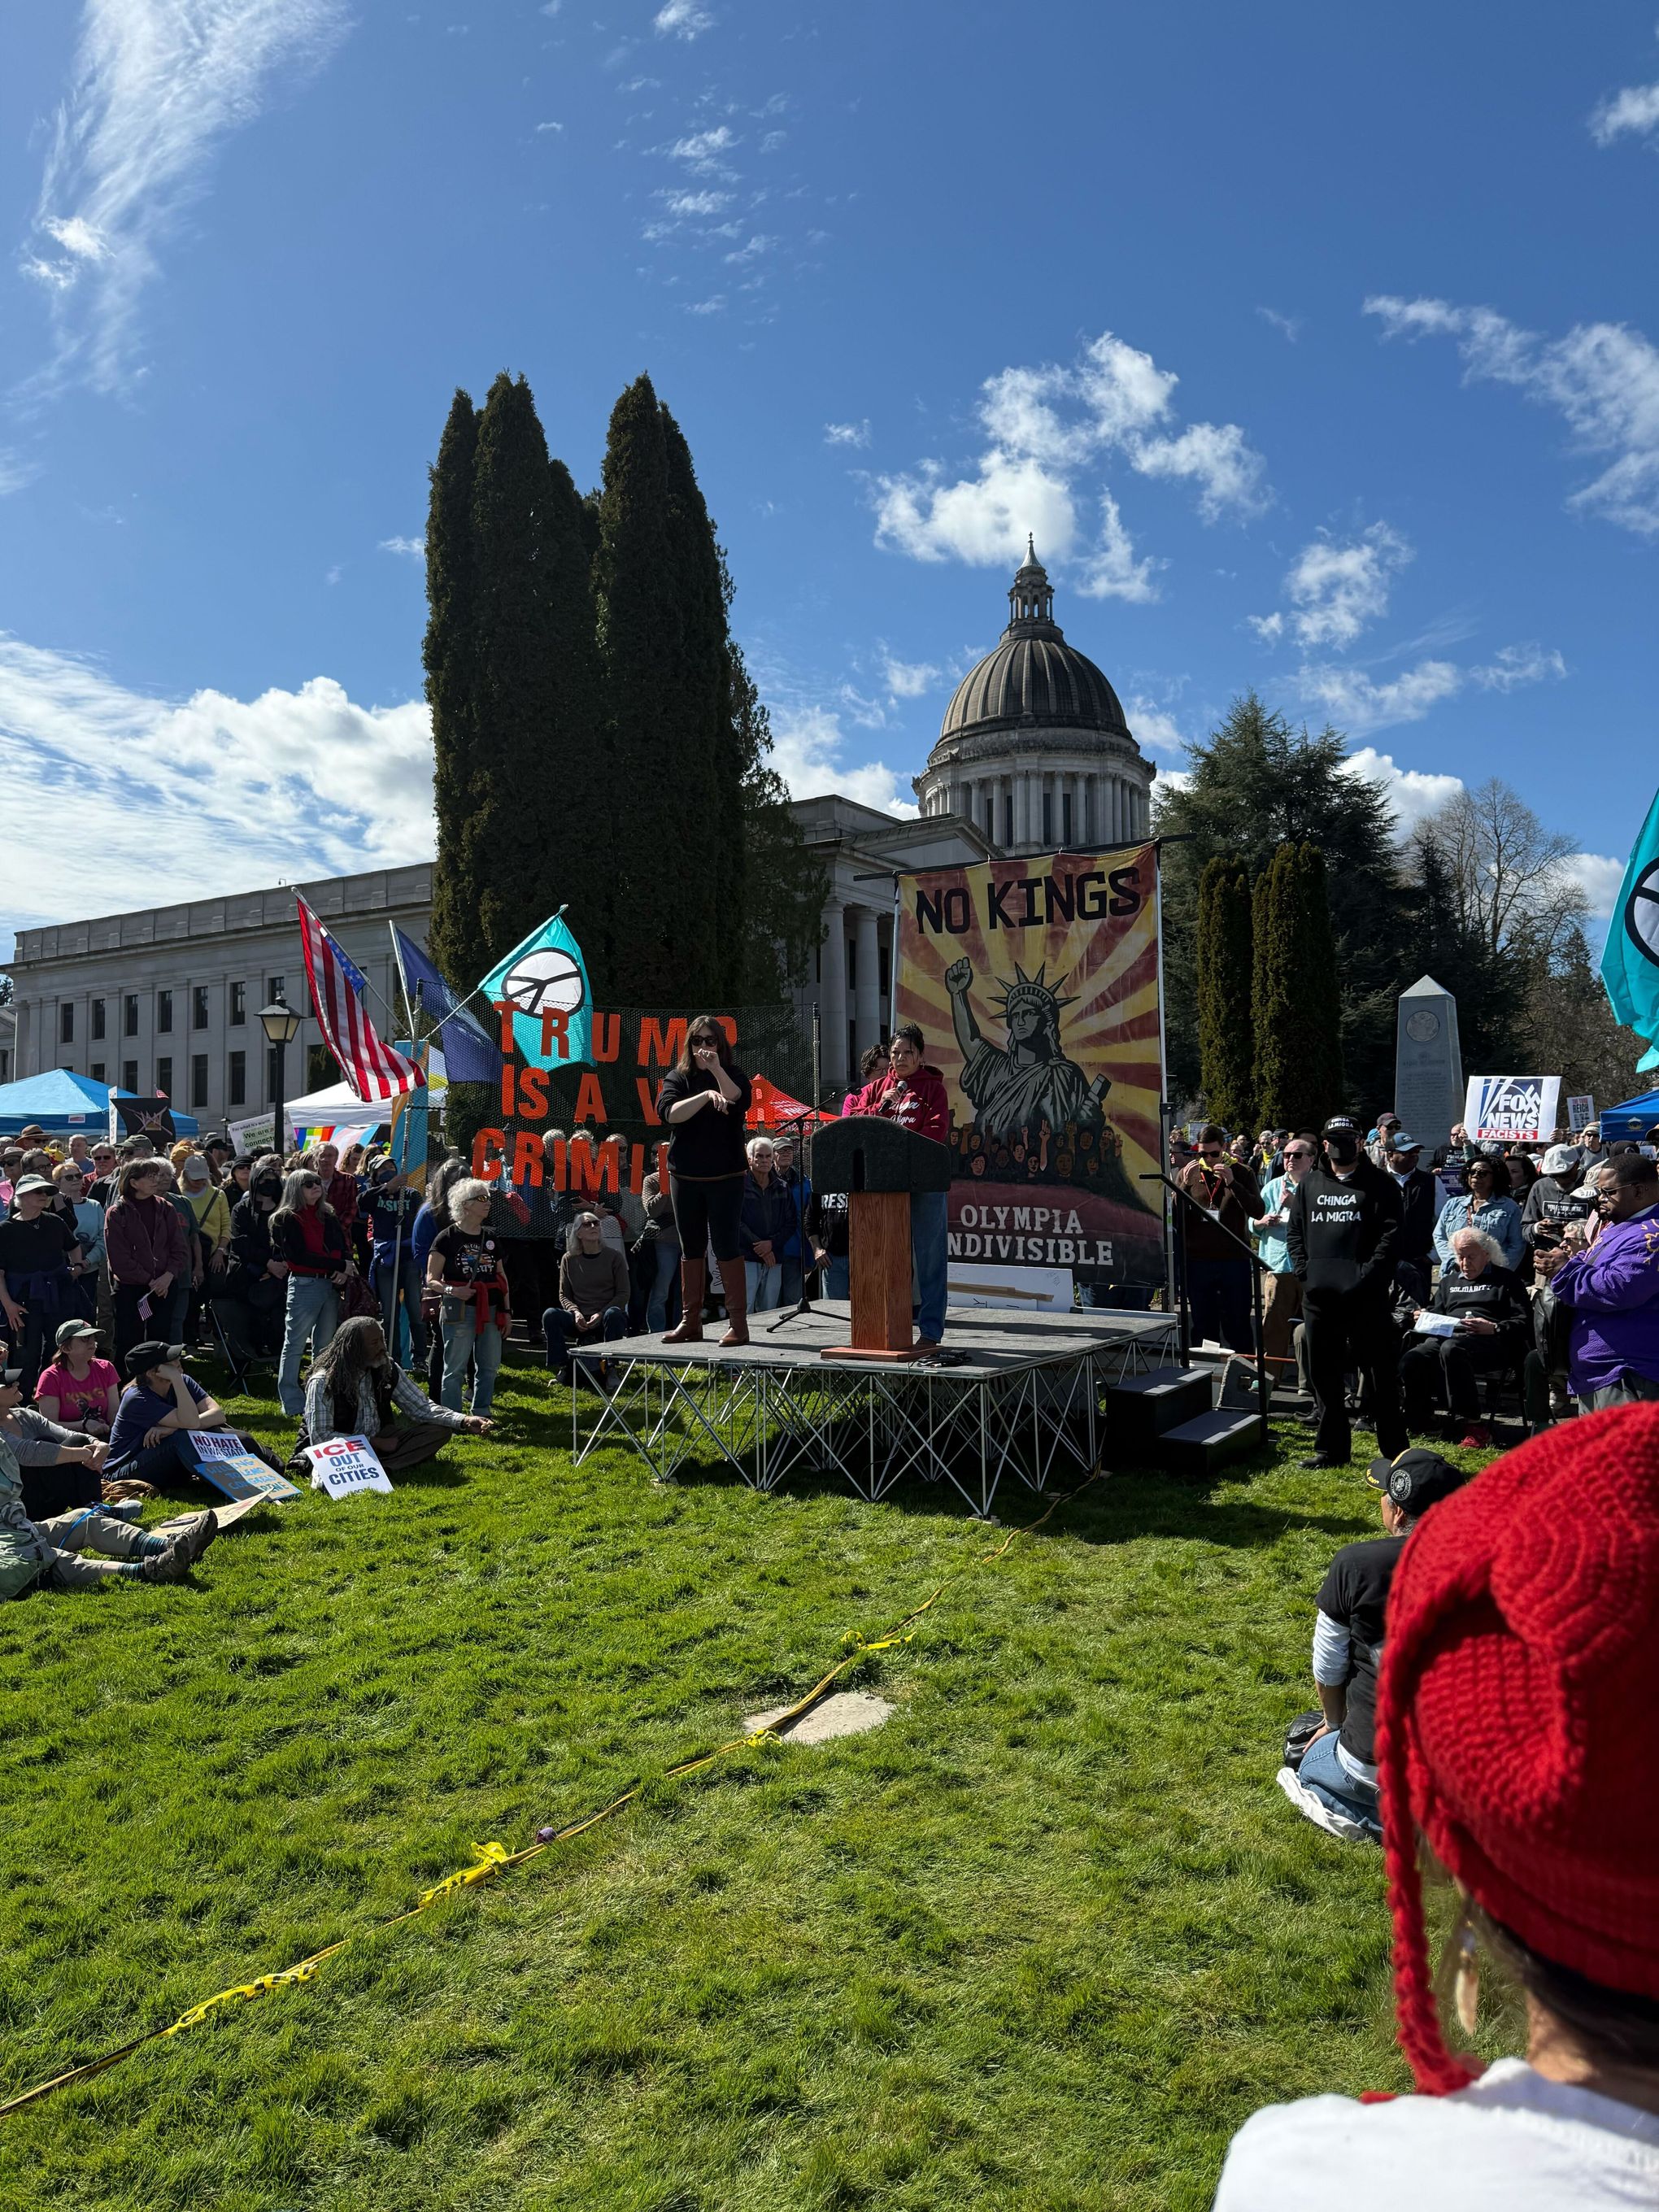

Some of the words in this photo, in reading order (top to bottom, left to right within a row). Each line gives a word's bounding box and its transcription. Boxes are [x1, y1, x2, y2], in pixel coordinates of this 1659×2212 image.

[917, 888, 970, 934] NO
[987, 867, 1140, 930] KINGS
[502, 1064, 550, 1120] IS
[574, 1073, 607, 1123] A
[1487, 1112, 1539, 1129] NEWS
[245, 1136, 275, 1147] connect
[1482, 1130, 1535, 1139] FACISTS
[1317, 1195, 1356, 1205] CHINGA
[960, 1204, 1084, 1234] OLYMPIA
[1311, 1211, 1323, 1222] LA
[1326, 1211, 1362, 1222] MIGRA
[947, 1233, 1113, 1266] NDIVISIBLE
[1450, 1284, 1491, 1293] SOLIDARITY
[193, 1435, 211, 1447] NO
[212, 1436, 242, 1448] HATE
[313, 1439, 367, 1459] ICE
[197, 1446, 208, 1455] IN
[209, 1447, 222, 1456] WA
[222, 1448, 244, 1457] STATE
[329, 1452, 360, 1467] OUT
[329, 1467, 380, 1485] CITIES
